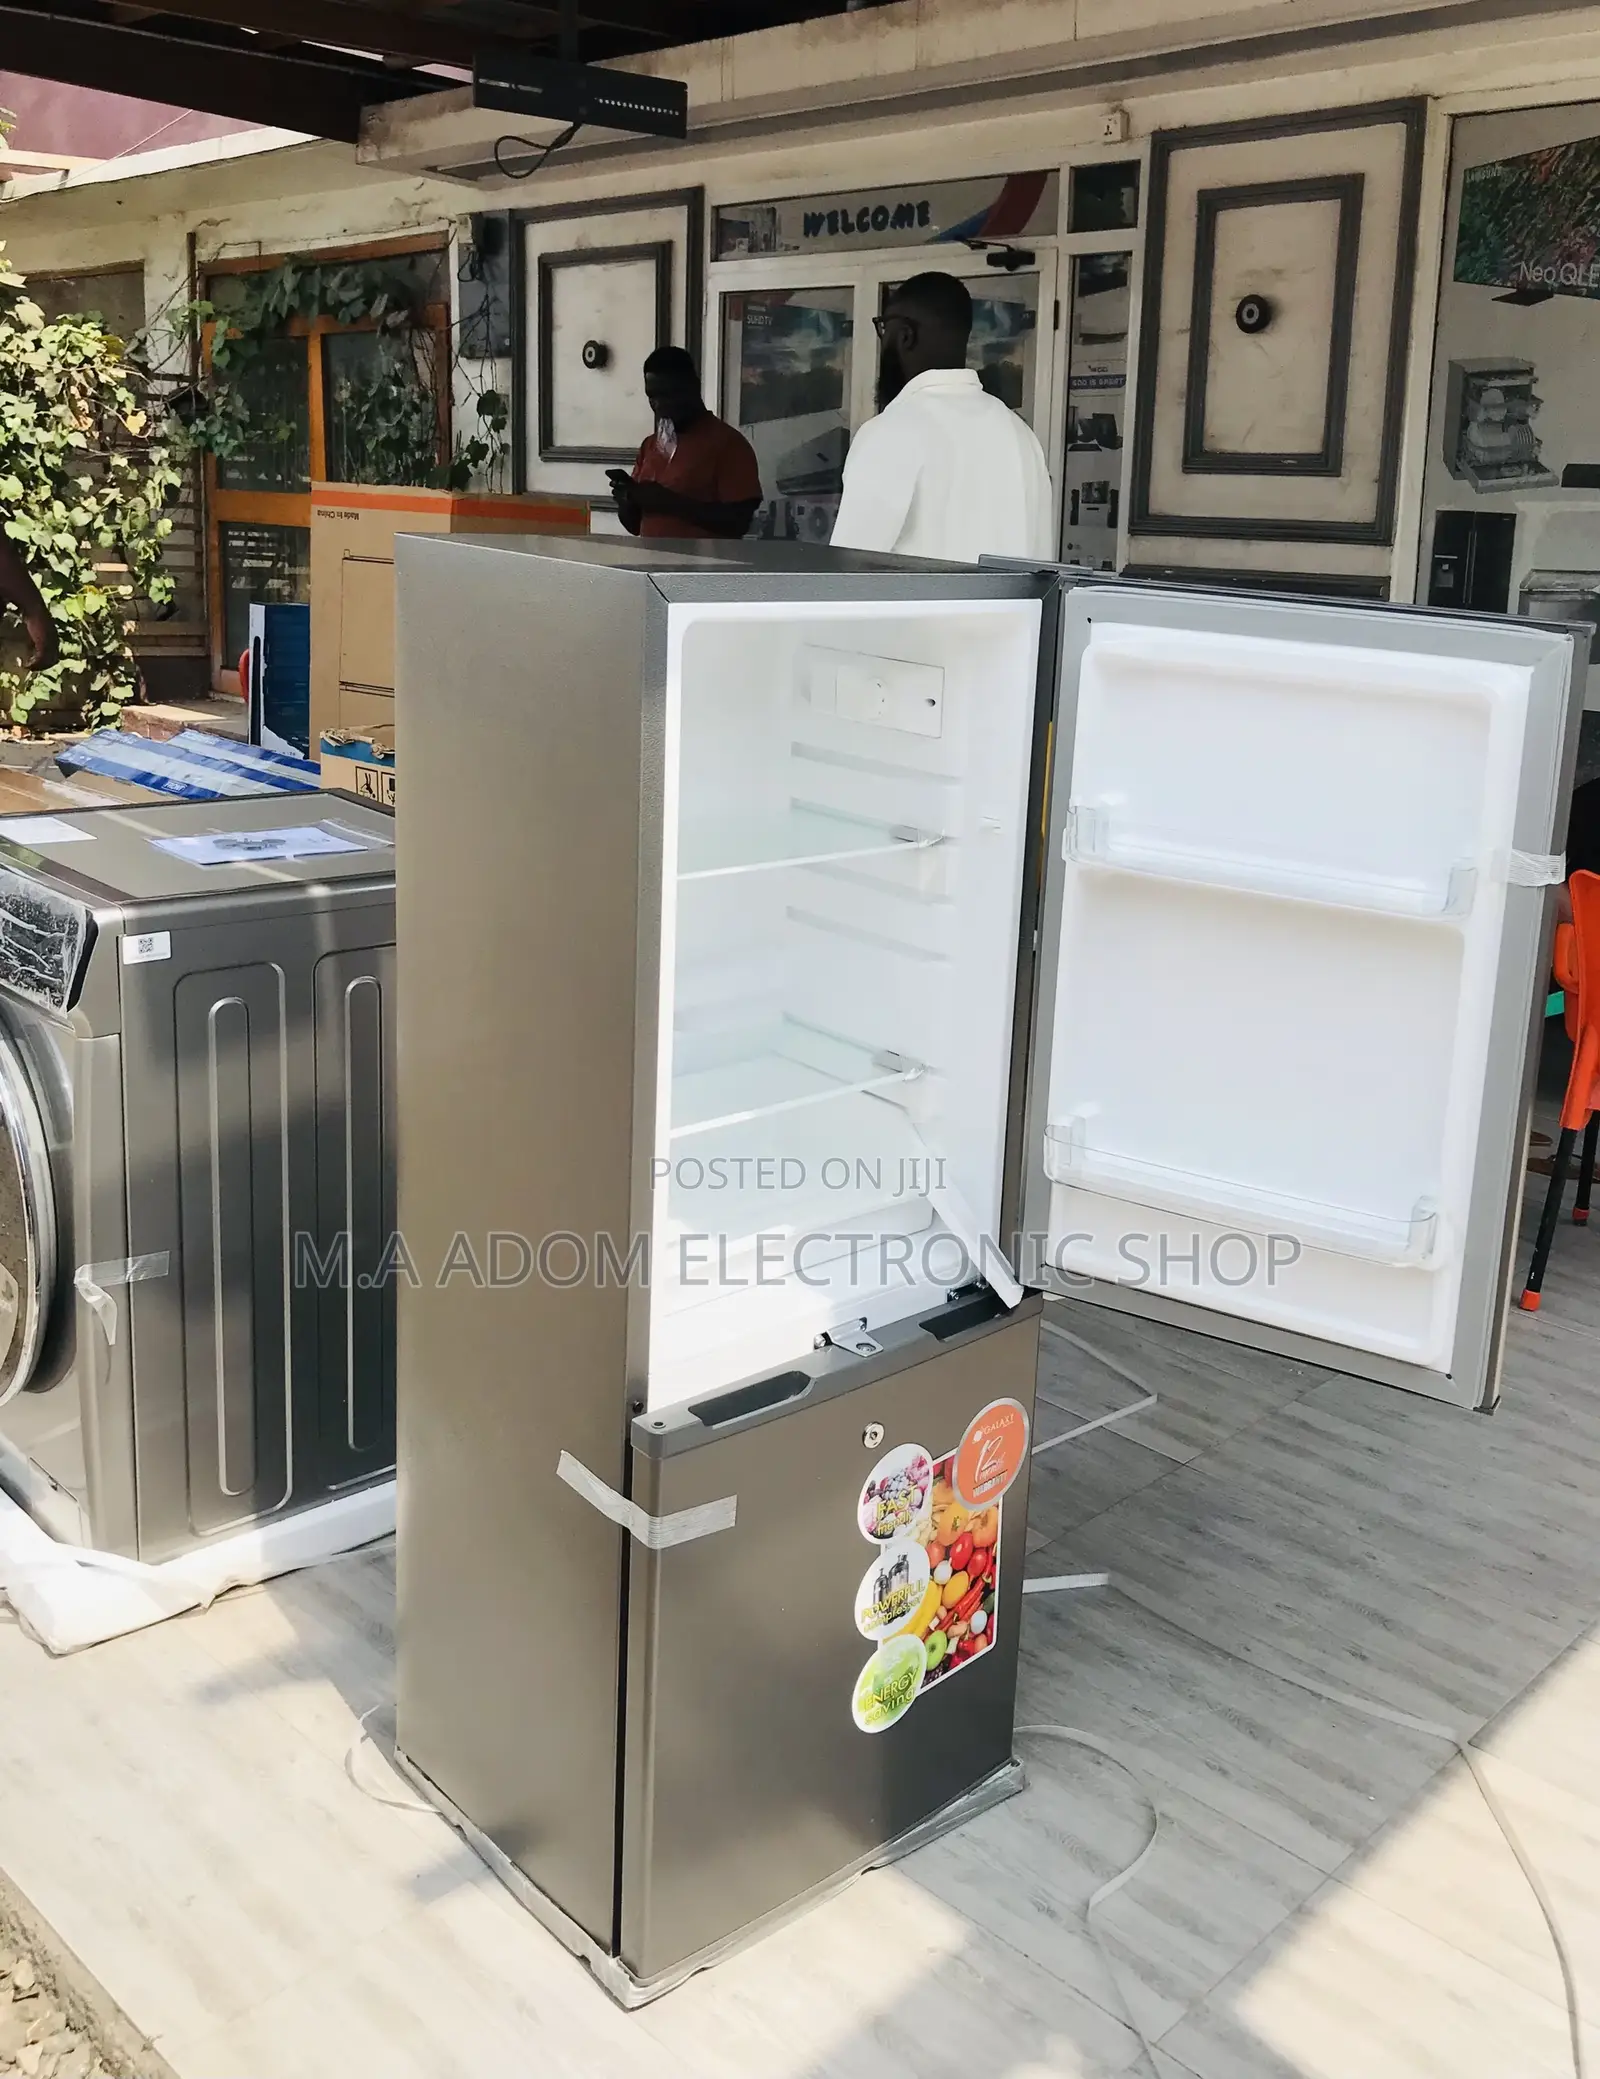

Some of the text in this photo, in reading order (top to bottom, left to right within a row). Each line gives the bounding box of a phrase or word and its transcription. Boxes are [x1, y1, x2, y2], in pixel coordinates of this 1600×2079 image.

[803, 201, 931, 238] WELCOME
[1519, 261, 1557, 283] Neo
[975, 1435, 1003, 1483] 12
[876, 1485, 918, 1521] FAST
[861, 1578, 926, 1624] POWERFUL
[864, 1666, 919, 1712] ENERGY
[864, 1688, 915, 1725] saving
